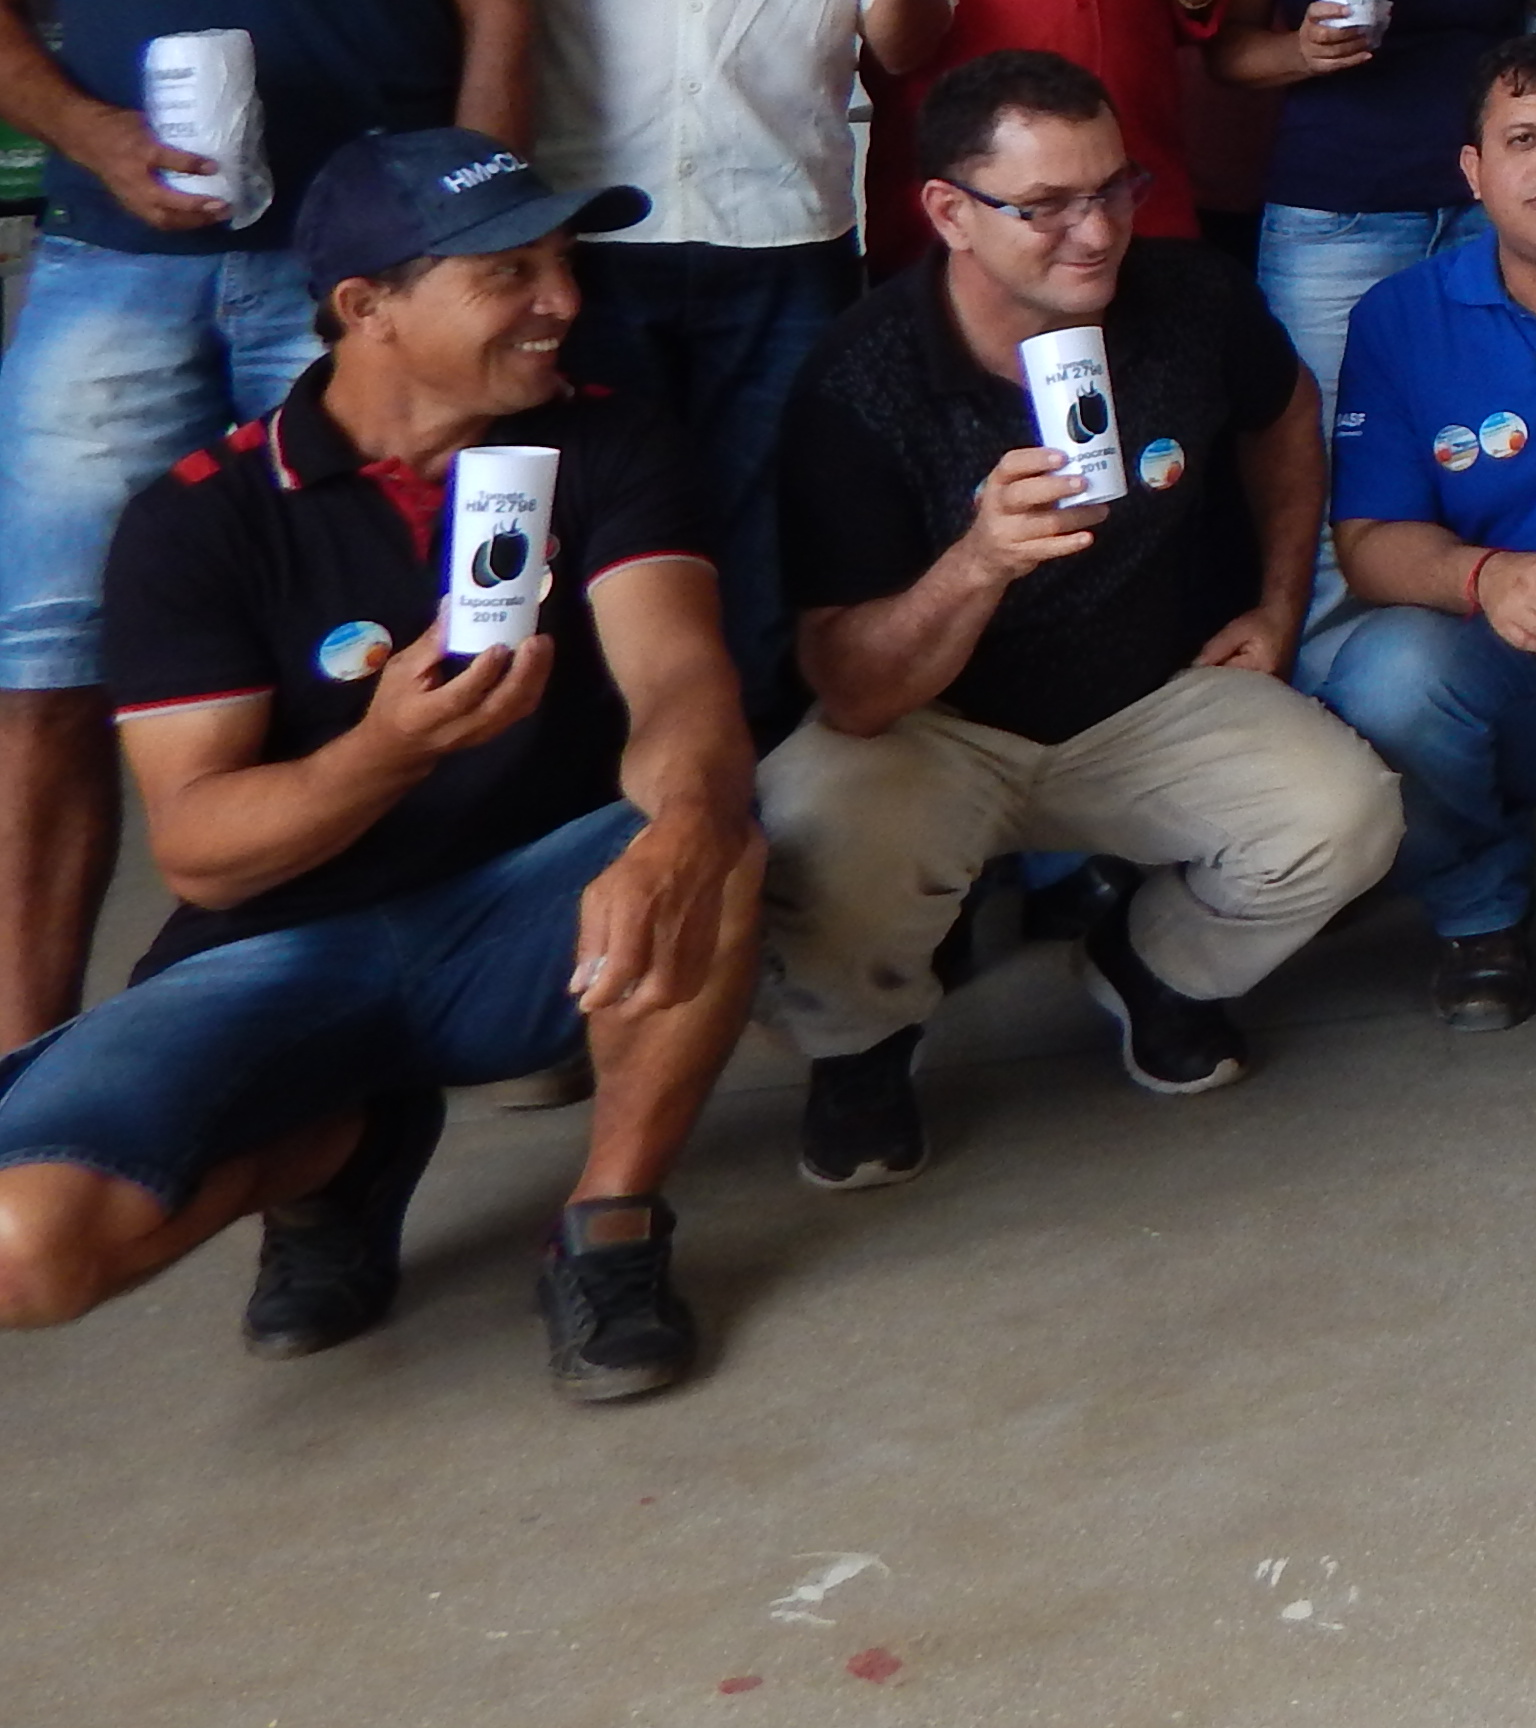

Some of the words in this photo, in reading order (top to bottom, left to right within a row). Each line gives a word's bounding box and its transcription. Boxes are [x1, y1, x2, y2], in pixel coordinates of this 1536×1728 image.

[1046, 370, 1069, 386] HM
[466, 499, 490, 513] HM
[495, 498, 538, 514] 2798
[473, 610, 508, 624] 2019
